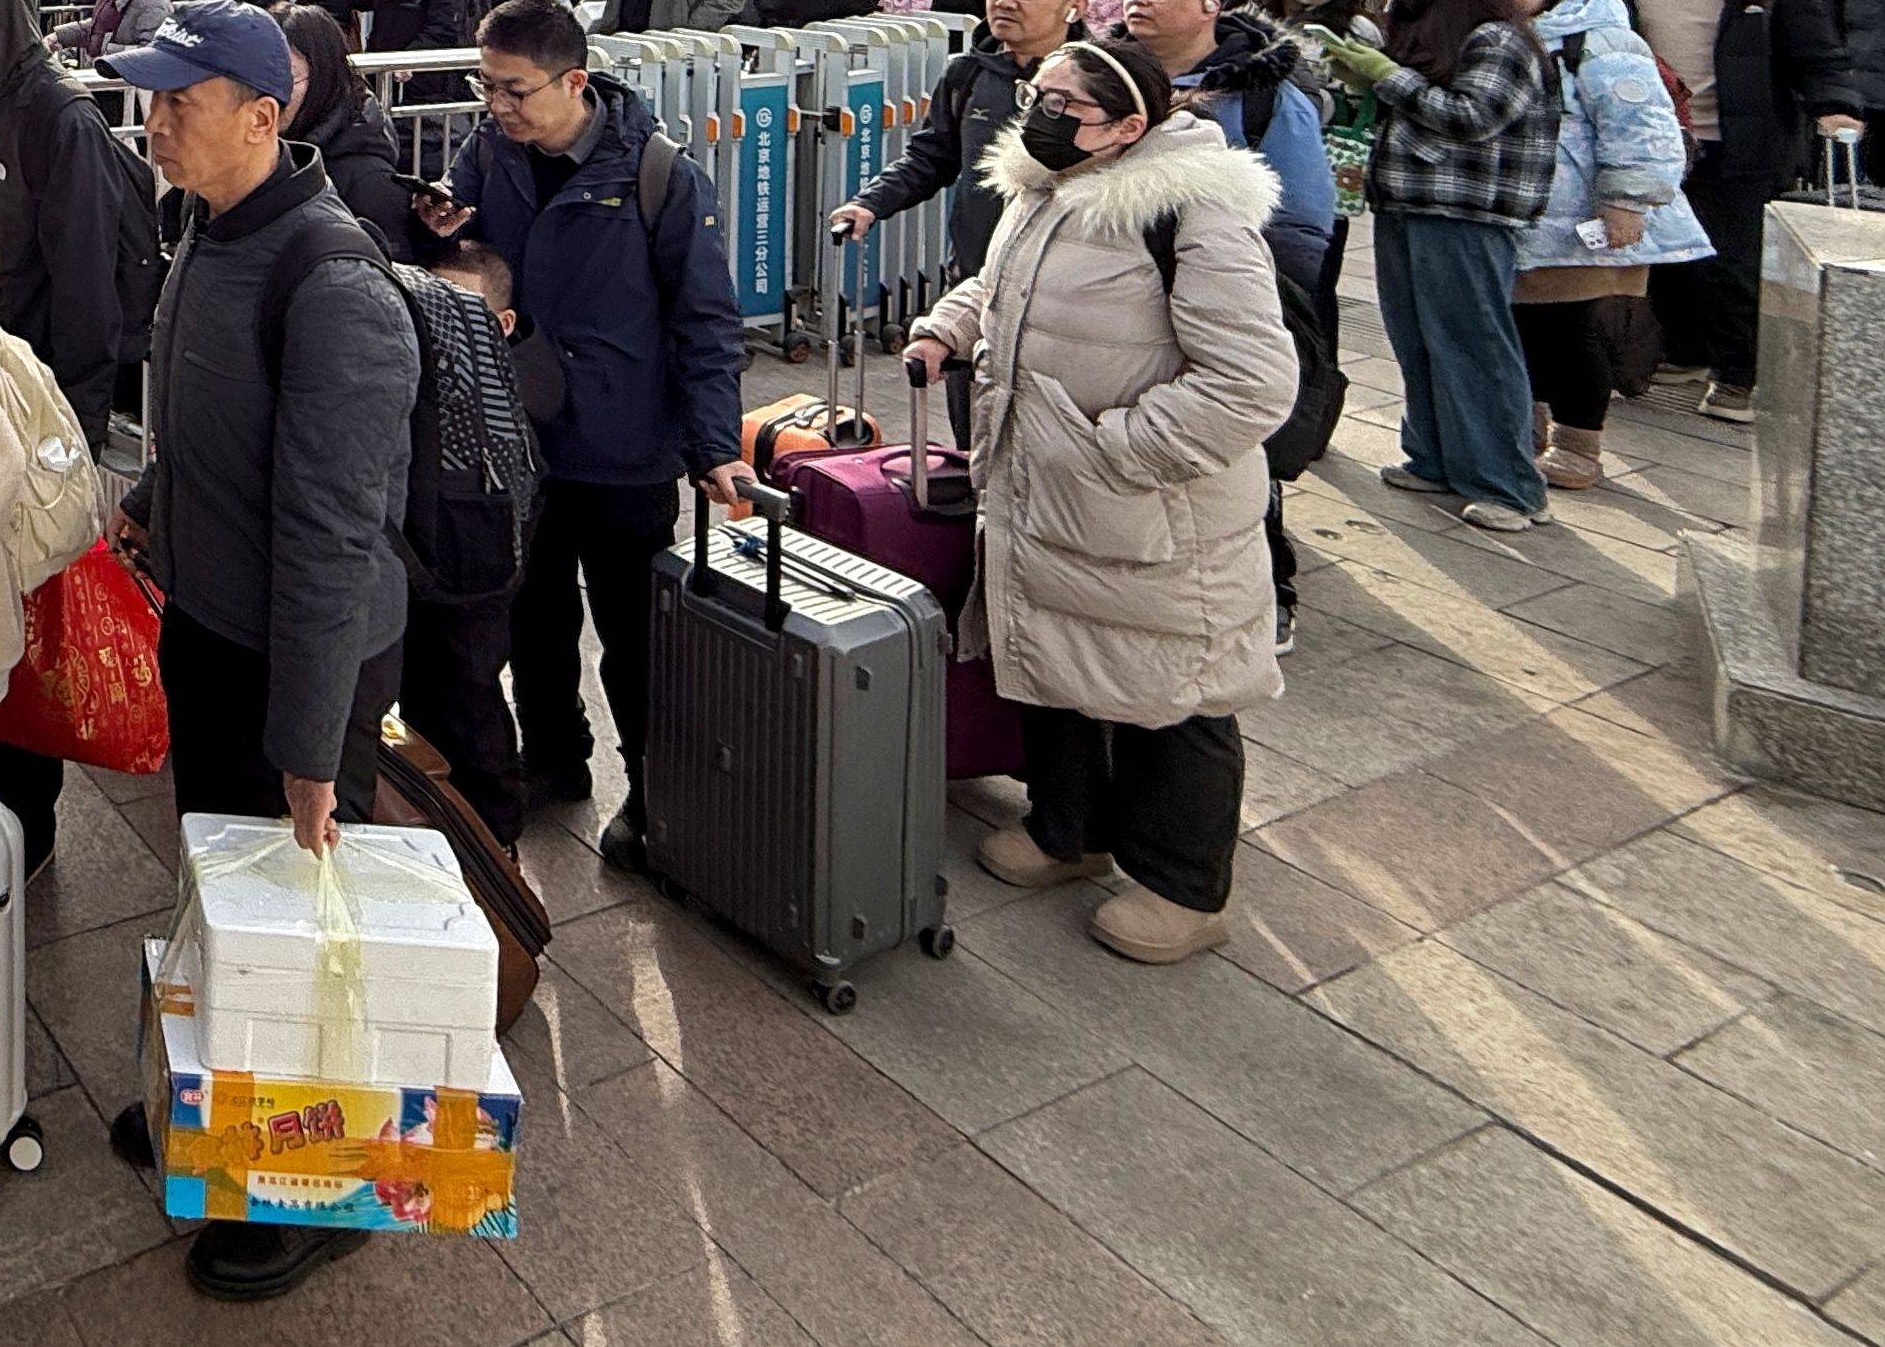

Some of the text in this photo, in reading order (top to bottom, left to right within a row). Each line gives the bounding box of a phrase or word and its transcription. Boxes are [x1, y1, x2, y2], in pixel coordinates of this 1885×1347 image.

[754, 131, 772, 295] 北京地铁运营三分公司
